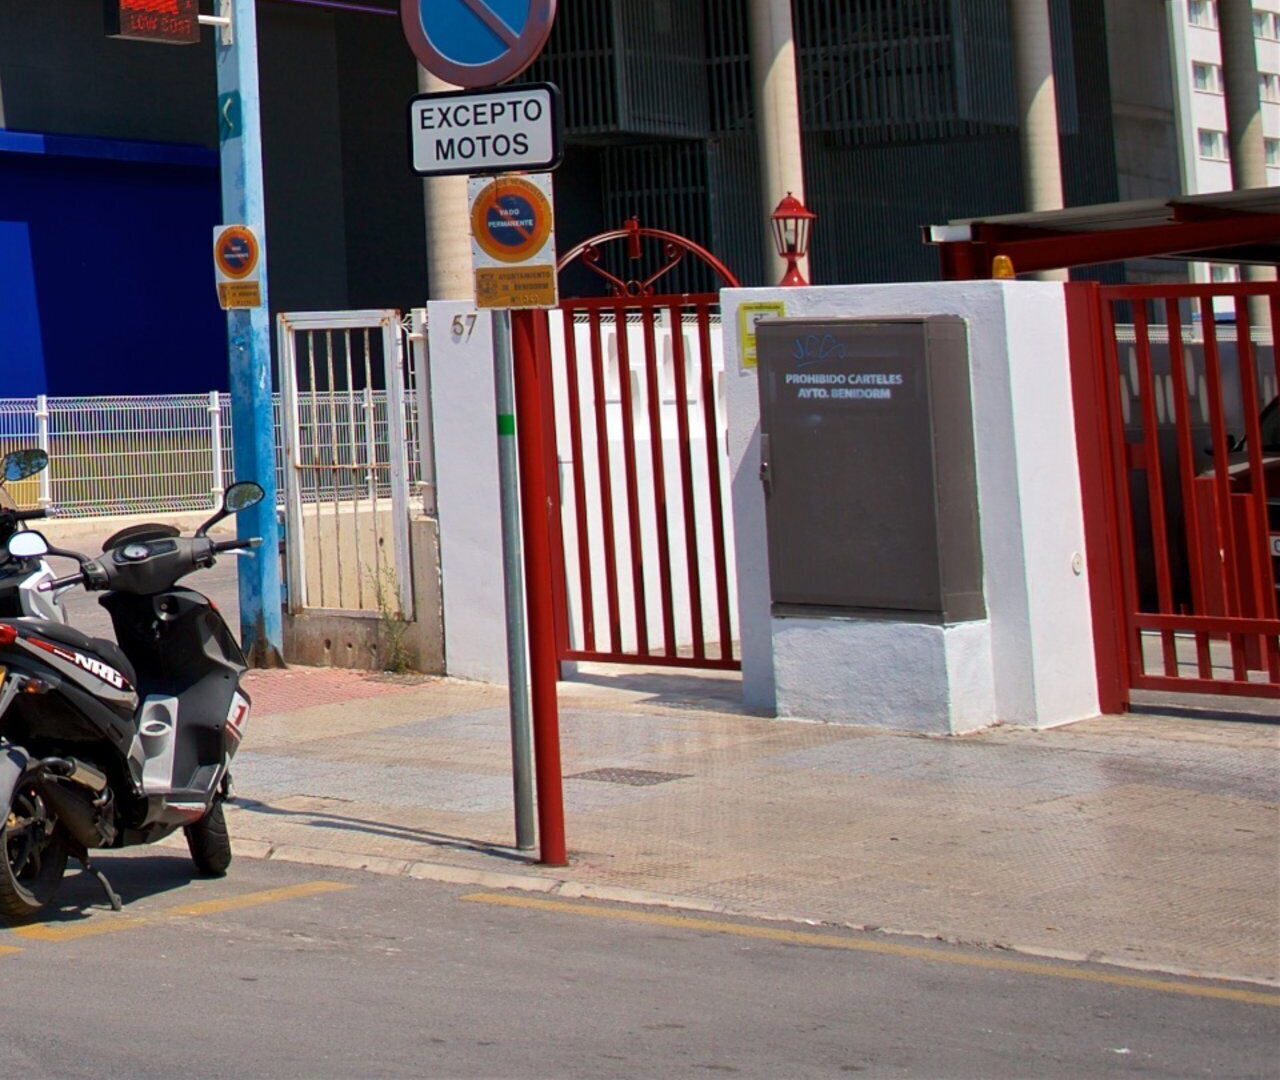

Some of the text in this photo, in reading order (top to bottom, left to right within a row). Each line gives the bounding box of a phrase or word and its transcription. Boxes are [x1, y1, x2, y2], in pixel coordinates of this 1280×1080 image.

[420, 98, 543, 130] EXCEPTO
[435, 133, 529, 161] MOTOS
[499, 208, 520, 216] VADO
[487, 219, 534, 228] PERMANENTE
[452, 314, 478, 337] 57
[785, 374, 903, 385] PROHIBIDO CARTELES
[798, 388, 891, 399] AYTO. BENIDORM
[73, 652, 124, 690] NRG
